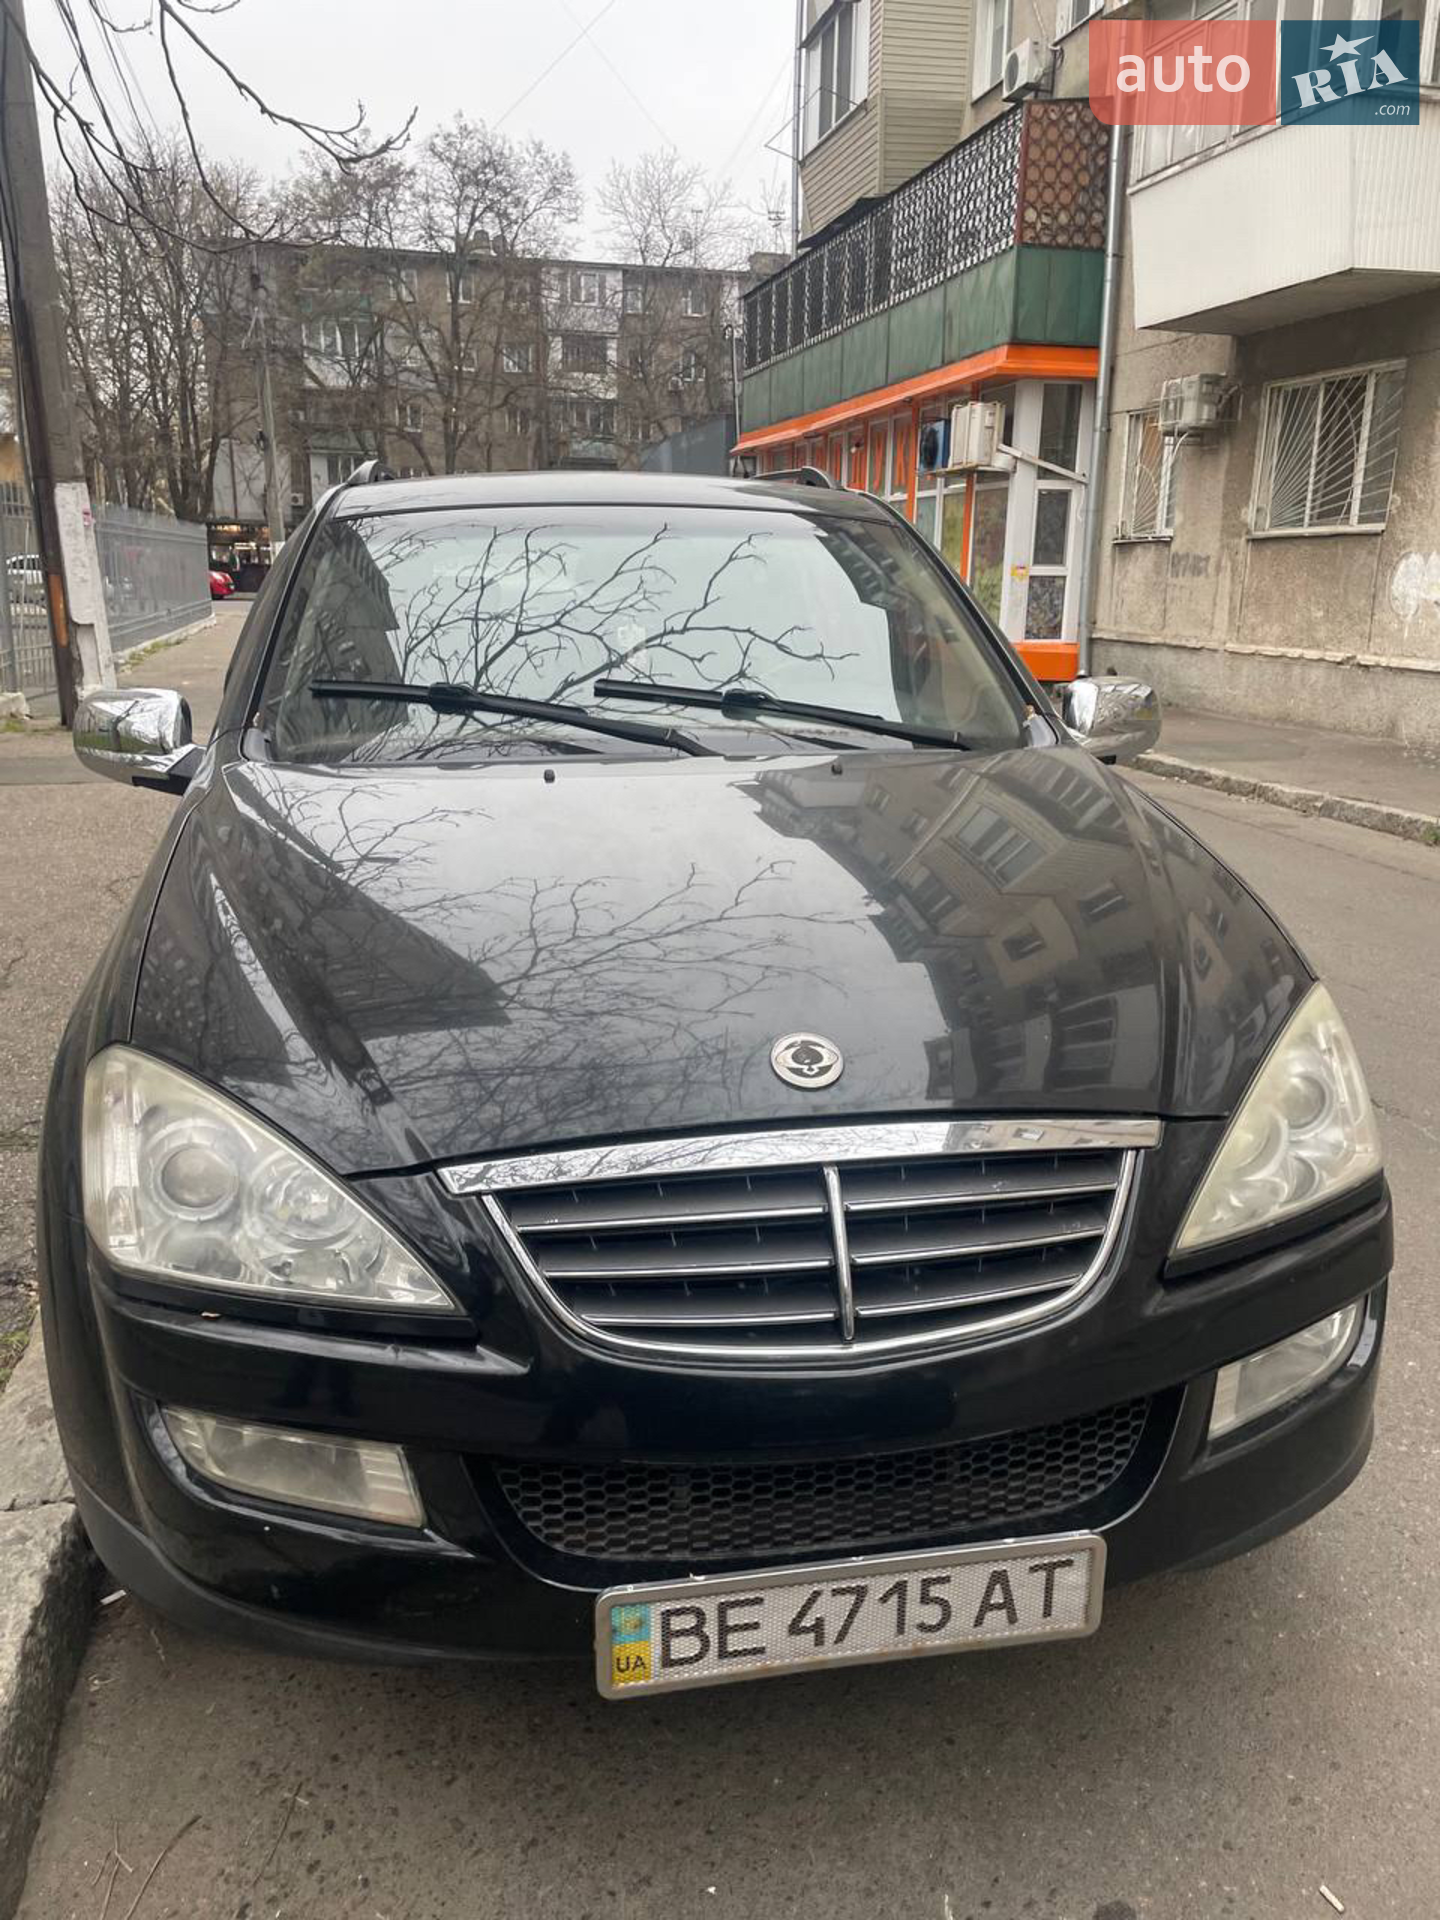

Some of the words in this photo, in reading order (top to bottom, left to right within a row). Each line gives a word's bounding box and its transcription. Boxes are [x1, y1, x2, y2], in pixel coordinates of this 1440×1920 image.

[660, 1596, 767, 1669] BE
[788, 1574, 952, 1647] 4715
[973, 1558, 1074, 1628] AT
[615, 1654, 647, 1674] UA
